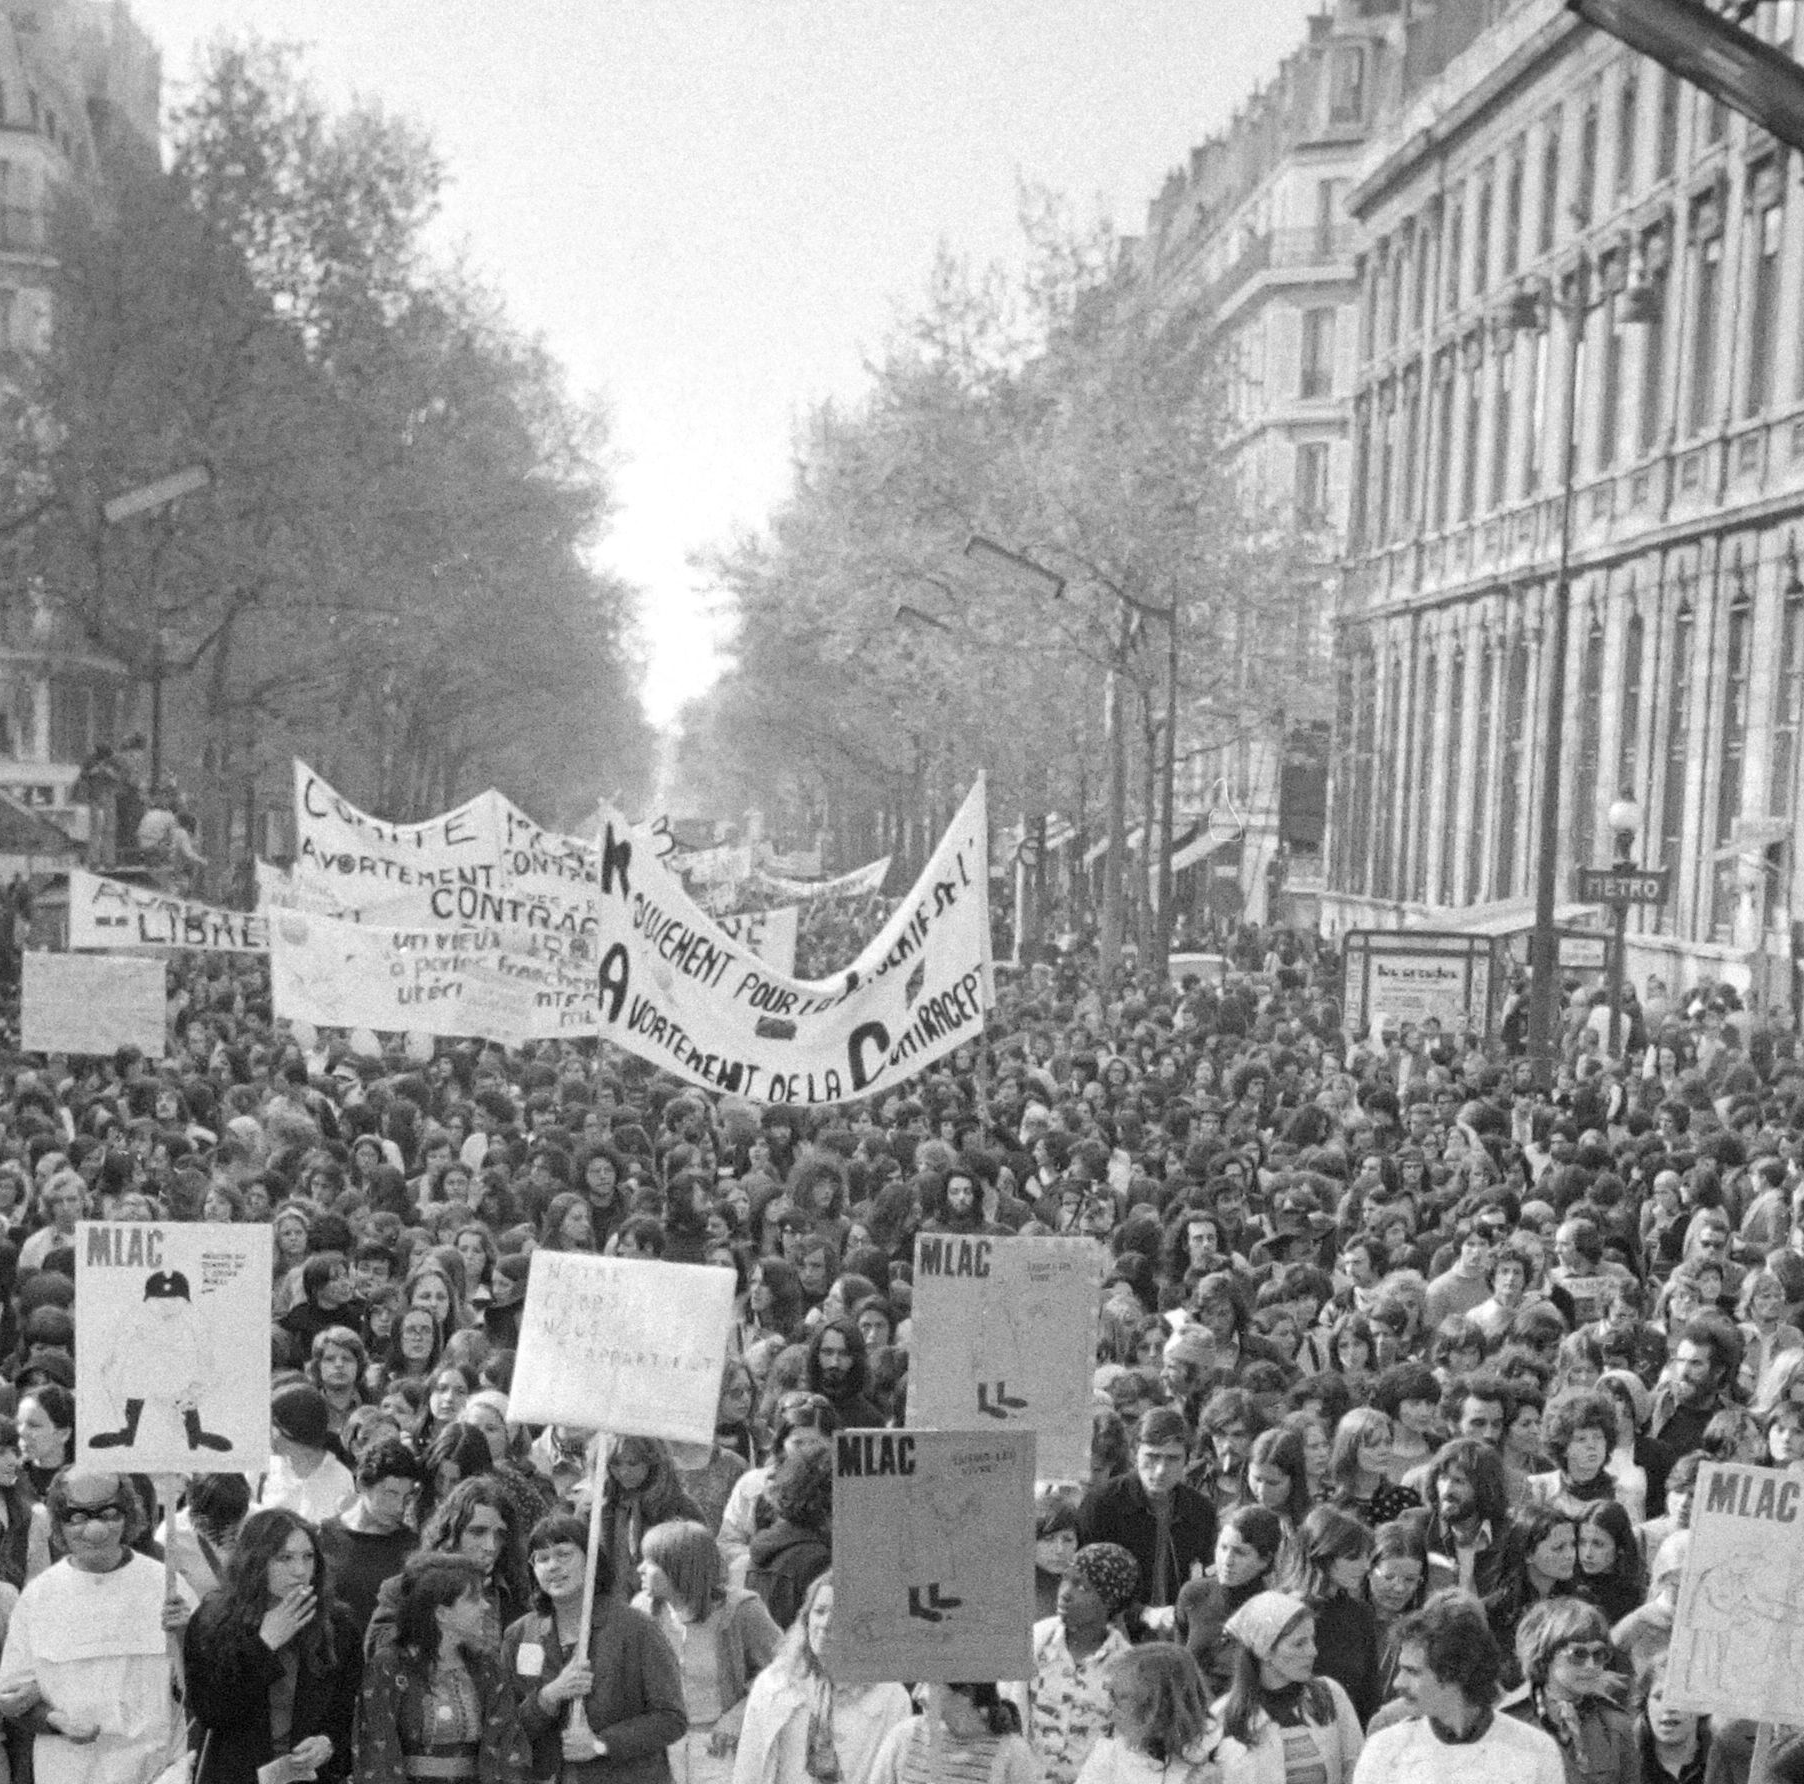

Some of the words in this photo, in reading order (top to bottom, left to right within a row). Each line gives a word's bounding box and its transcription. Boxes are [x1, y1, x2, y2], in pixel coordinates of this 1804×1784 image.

[301, 837, 496, 888] AVORTEMENT
[1587, 878, 1658, 898] METRO
[598, 941, 761, 1096] AVORTEMENT
[767, 1071, 801, 1104] DE
[807, 1068, 843, 1104] LA
[86, 1226, 164, 1269] MLAC
[919, 1238, 993, 1278] MLAC
[836, 1435, 917, 1477] MLAC
[1705, 1470, 1801, 1524] MLAC
